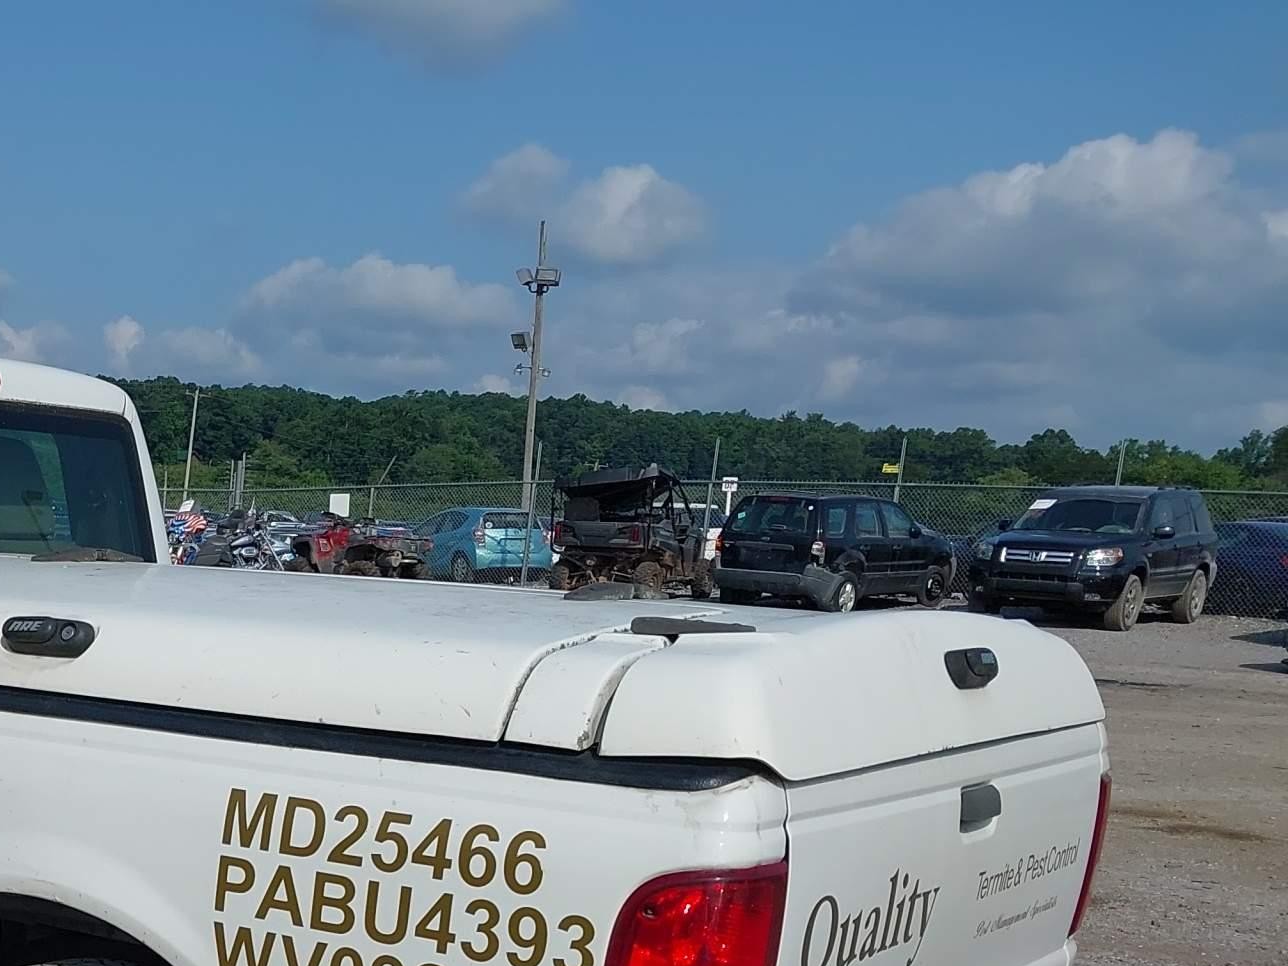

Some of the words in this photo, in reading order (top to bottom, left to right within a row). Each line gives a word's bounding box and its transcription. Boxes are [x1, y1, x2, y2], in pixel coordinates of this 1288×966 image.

[222, 787, 548, 896] MD25466
[976, 871, 1014, 901] Termite
[1013, 858, 1024, 887] &
[1024, 850, 1049, 883] Pest
[1047, 837, 1081, 873] Control
